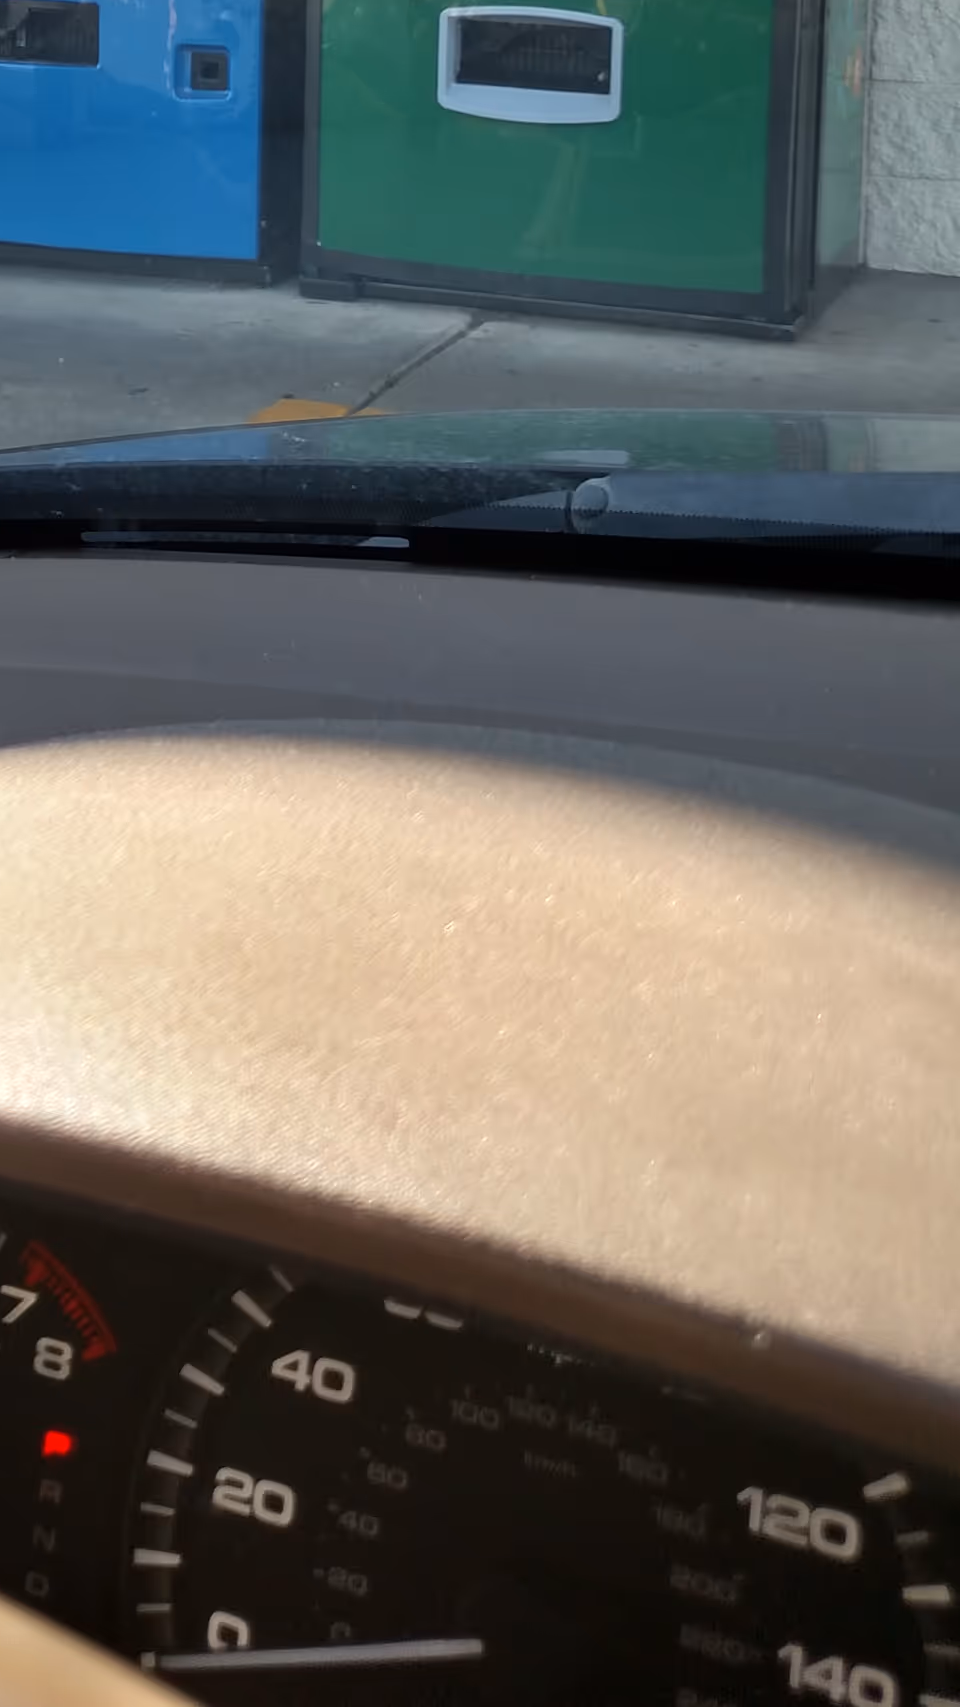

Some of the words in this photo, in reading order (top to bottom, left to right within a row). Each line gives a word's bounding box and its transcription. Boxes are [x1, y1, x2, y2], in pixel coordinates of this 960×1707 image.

[0, 1284, 38, 1323] 7
[34, 1337, 74, 1381] 8
[271, 1350, 356, 1404] 40
[212, 1466, 296, 1528] 20
[737, 1485, 862, 1561] 120
